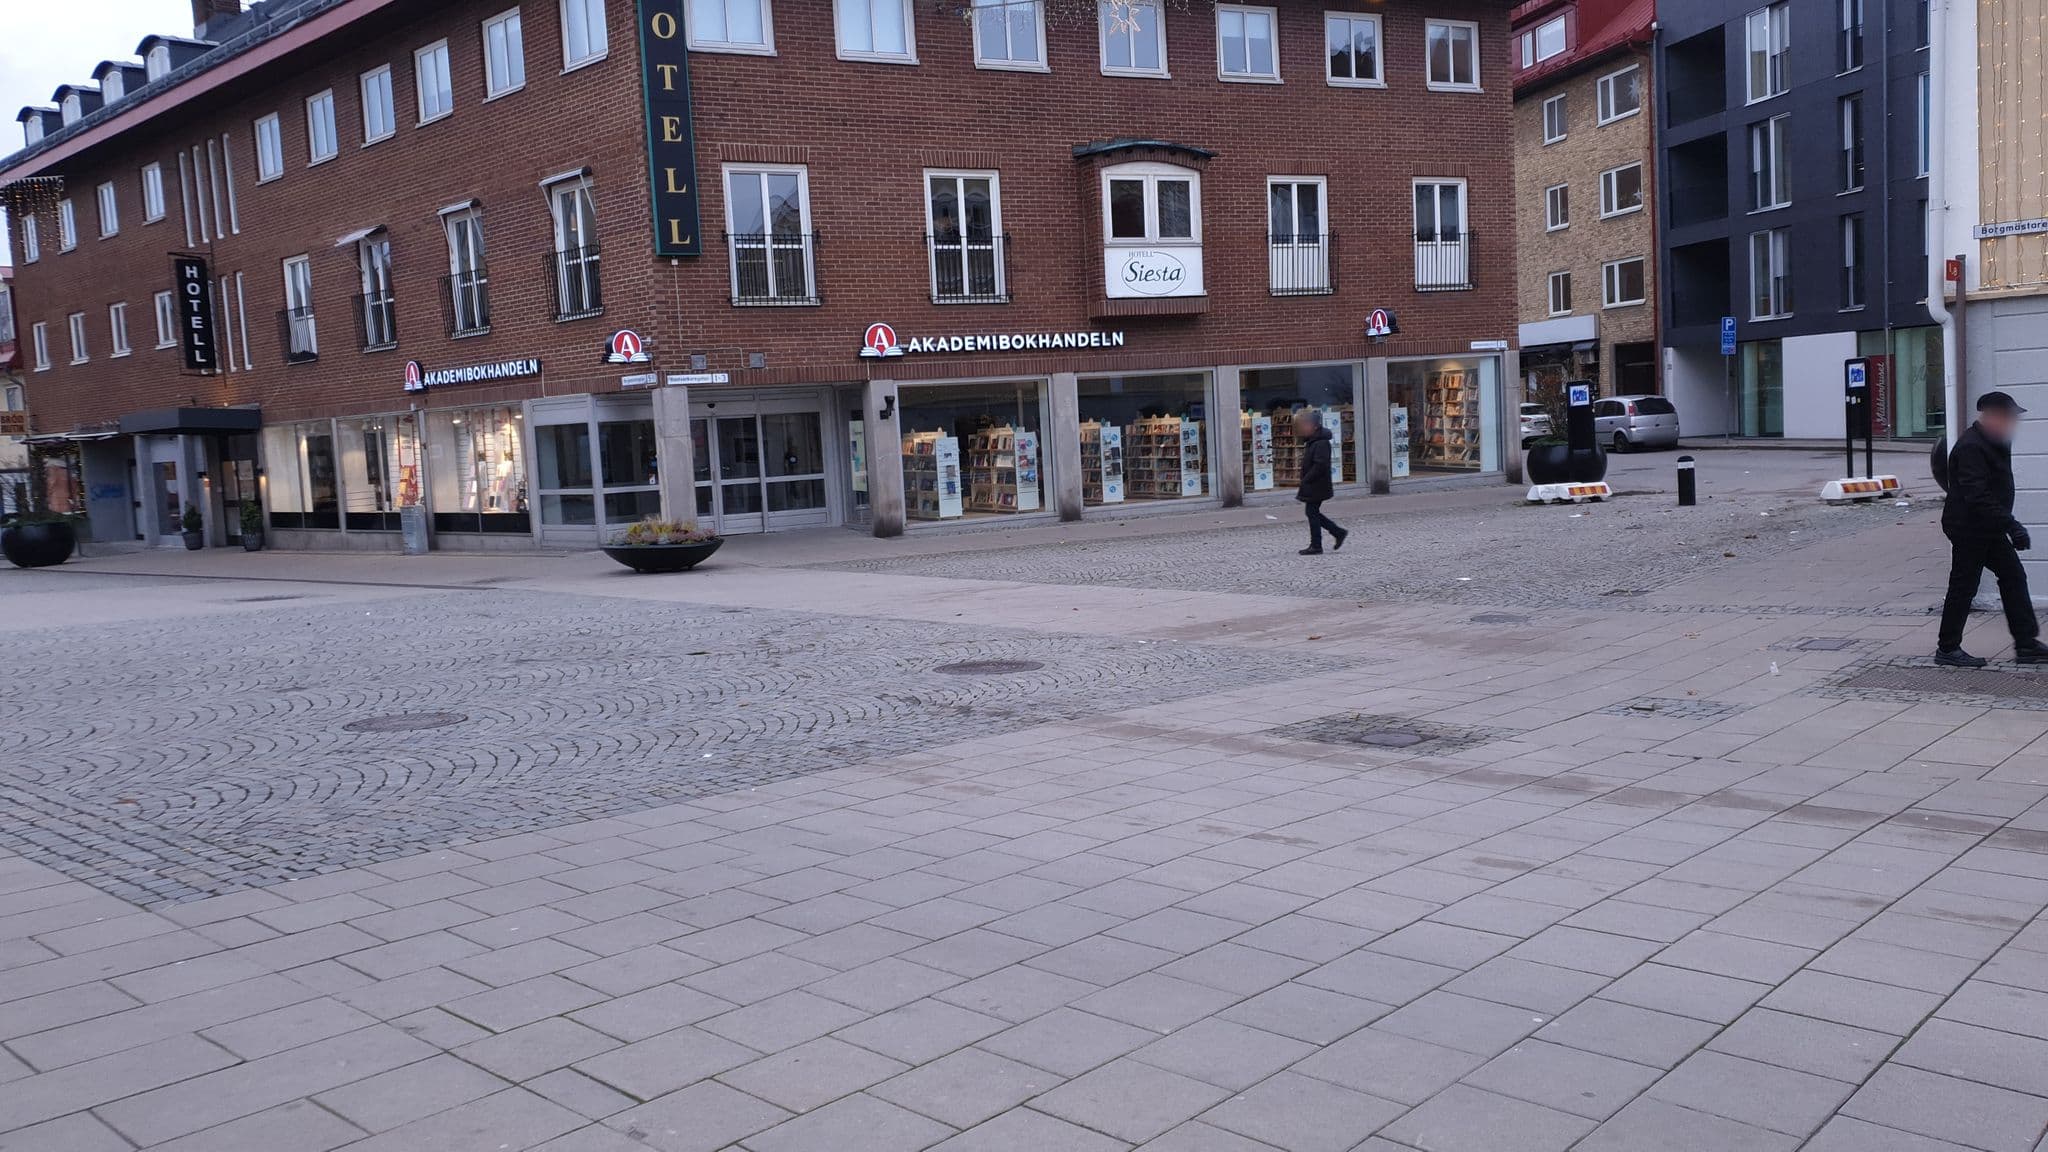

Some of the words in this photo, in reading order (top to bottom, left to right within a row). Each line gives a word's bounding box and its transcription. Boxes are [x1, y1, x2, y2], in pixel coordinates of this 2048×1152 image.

[651, 12, 691, 245] OTELL
[1128, 250, 1154, 258] HOTELL
[1125, 261, 1182, 282] Siesta
[185, 265, 207, 362] HOTELL
[1725, 319, 1734, 331] P
[908, 331, 1125, 353] AKADEMIBOKHANDELN
[424, 358, 538, 386] AKADEMIBOKHANDELN
